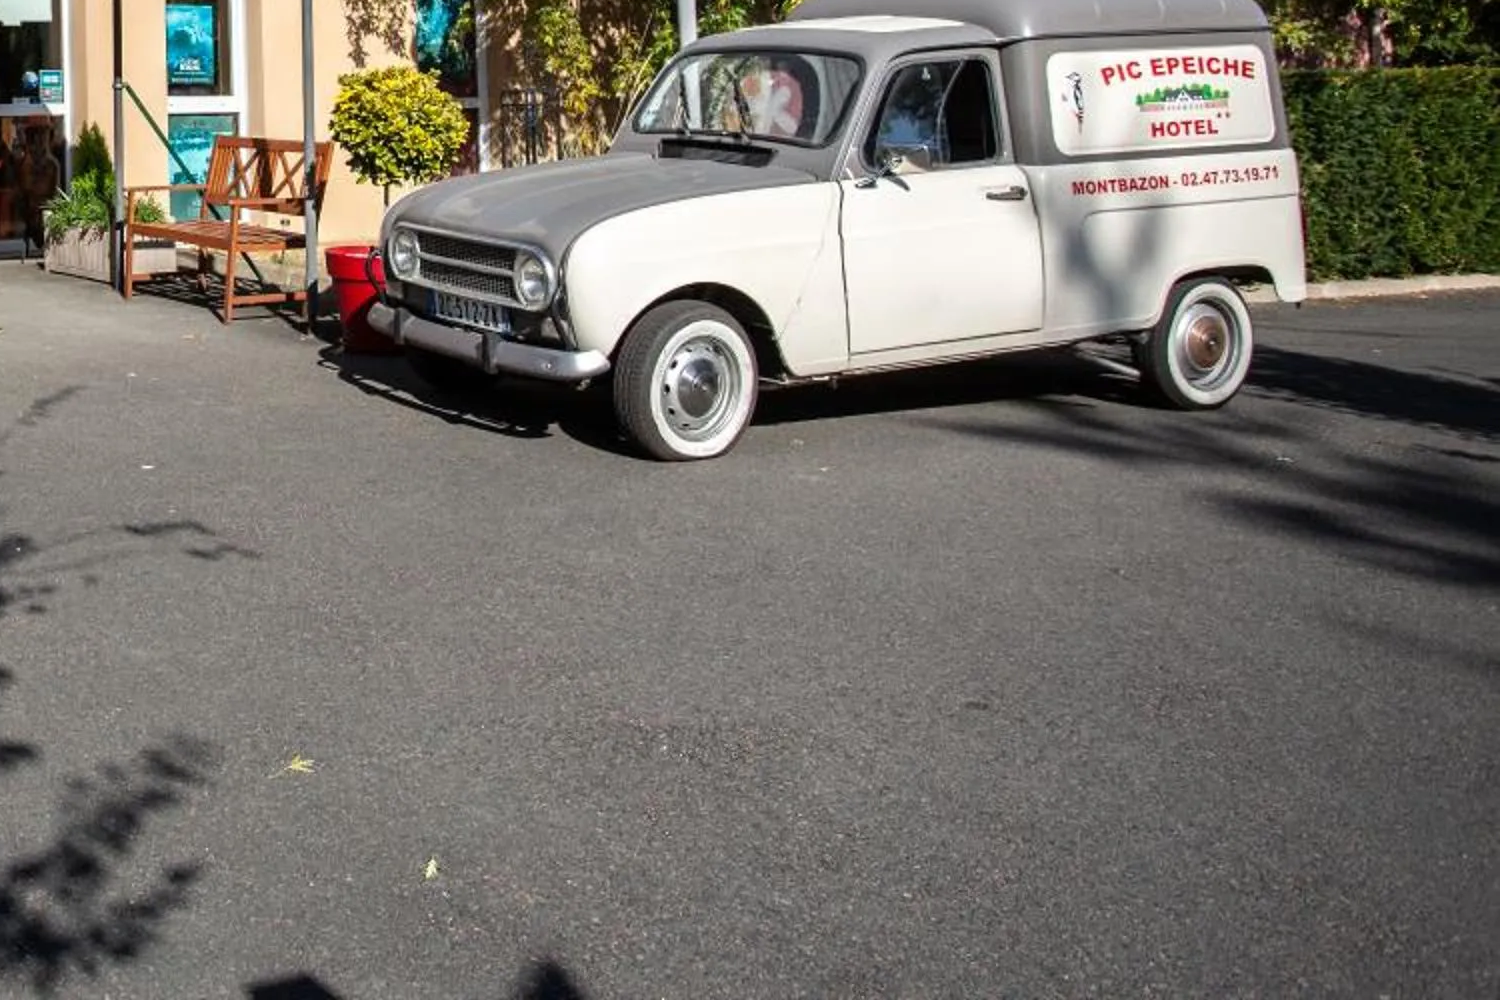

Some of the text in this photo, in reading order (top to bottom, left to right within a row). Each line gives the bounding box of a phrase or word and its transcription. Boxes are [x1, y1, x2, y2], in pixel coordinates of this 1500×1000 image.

[1100, 56, 1256, 86] PIC EPEICHE
[1151, 119, 1219, 139] HOTEL
[1071, 175, 1169, 196] MONTBAZON
